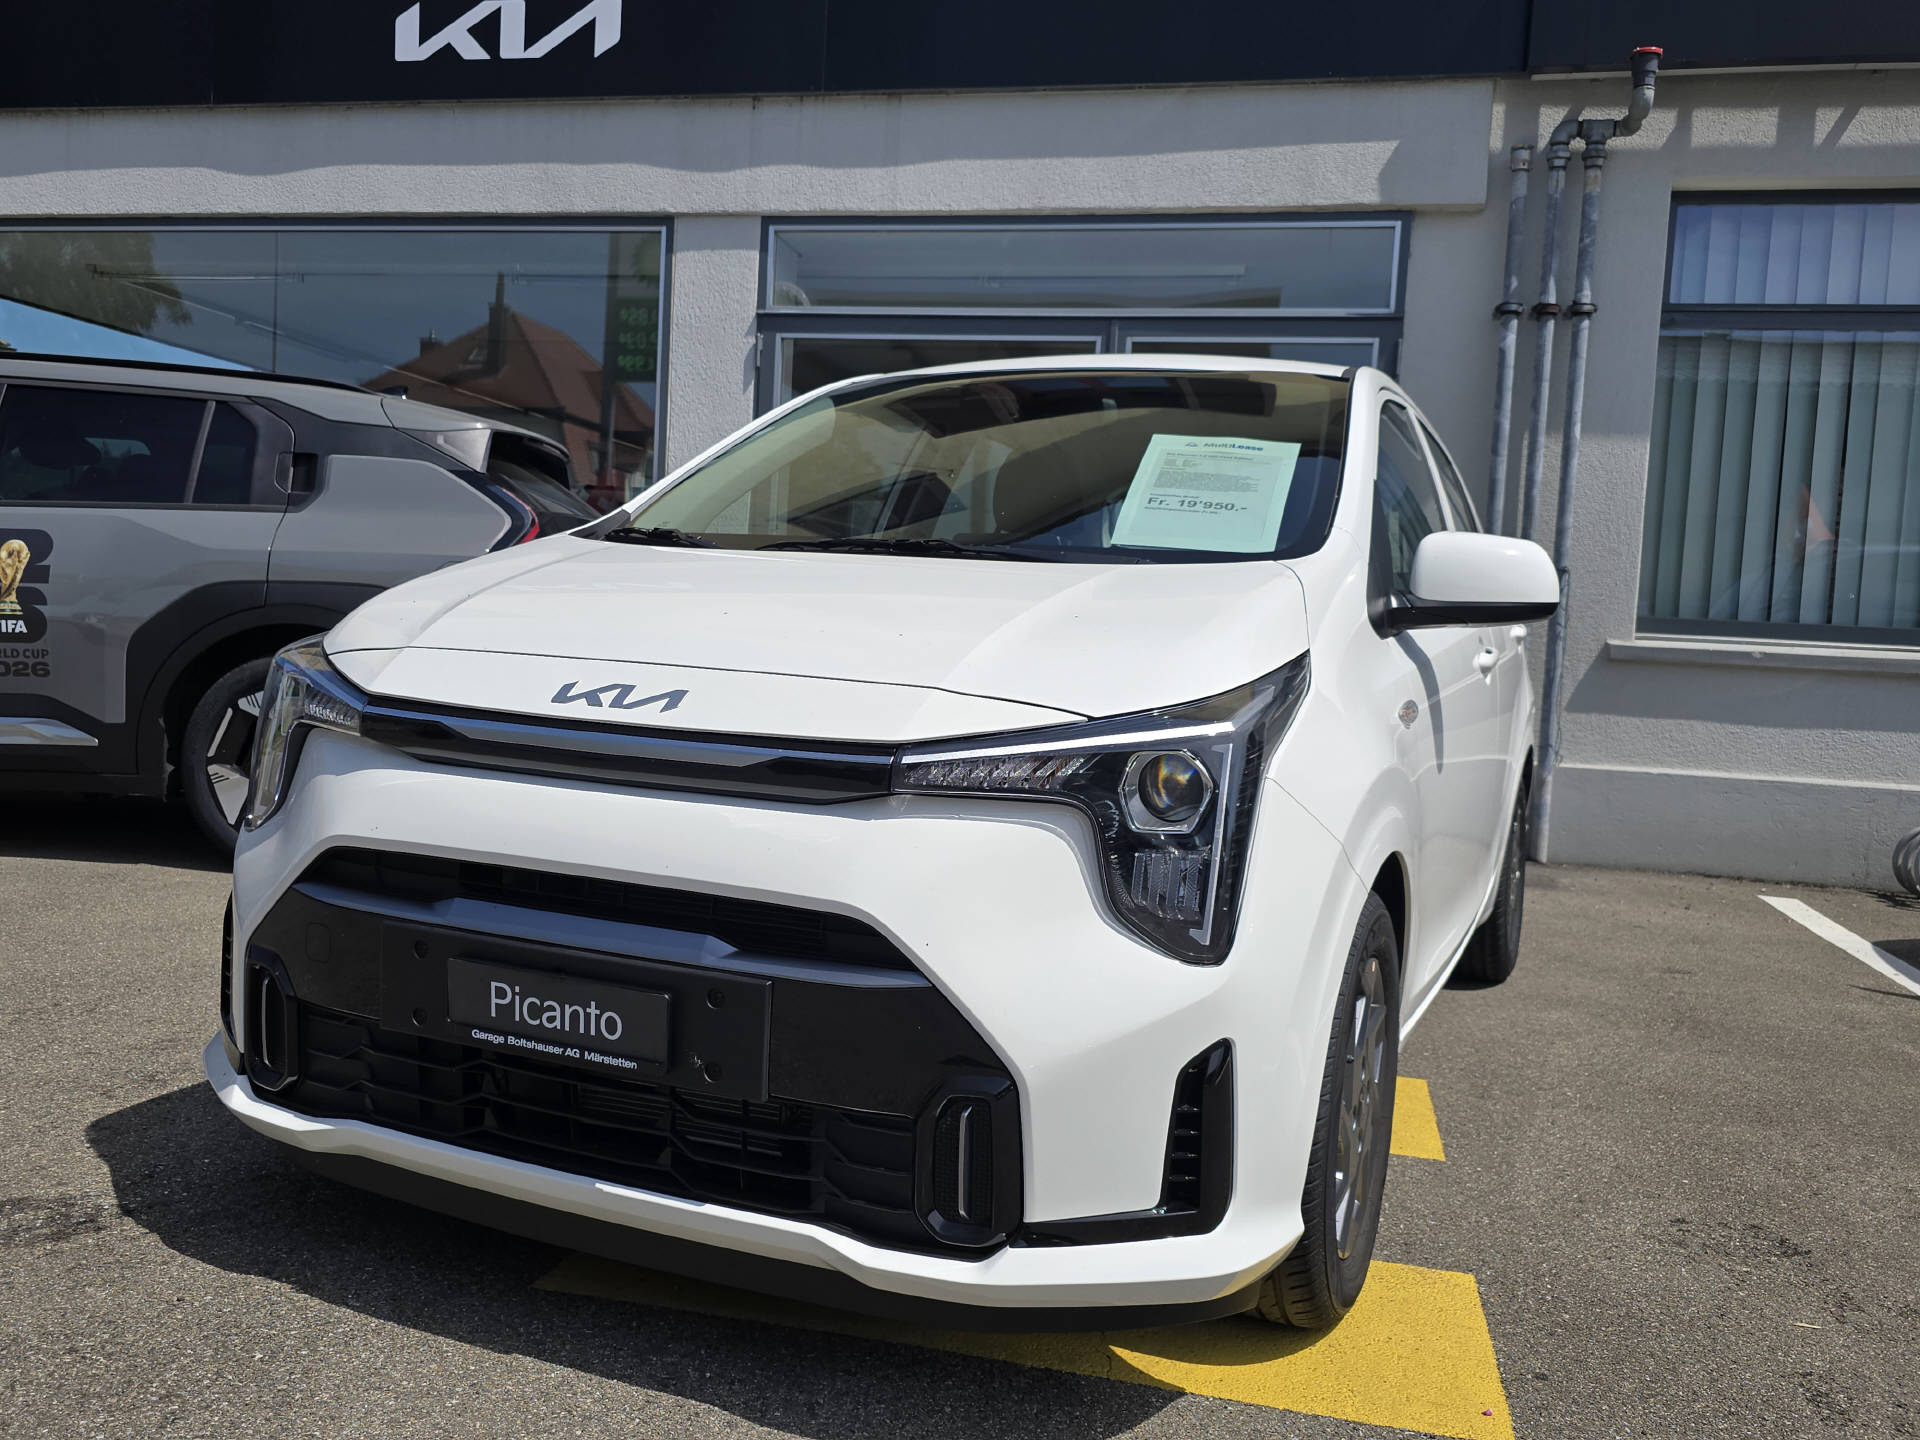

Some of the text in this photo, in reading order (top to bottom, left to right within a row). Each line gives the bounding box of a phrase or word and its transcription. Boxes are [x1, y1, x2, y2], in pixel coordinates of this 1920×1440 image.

[395, 0, 622, 61] KIA
[1147, 497, 1170, 506] Fr.
[1178, 499, 1247, 512] 19'950.-
[0, 619, 28, 633] IFA
[23, 648, 49, 660] CUP
[551, 681, 690, 713] KIA
[490, 980, 623, 1041] Picanto
[471, 1029, 638, 1070] Garage Boltshauser AG Märstetten
